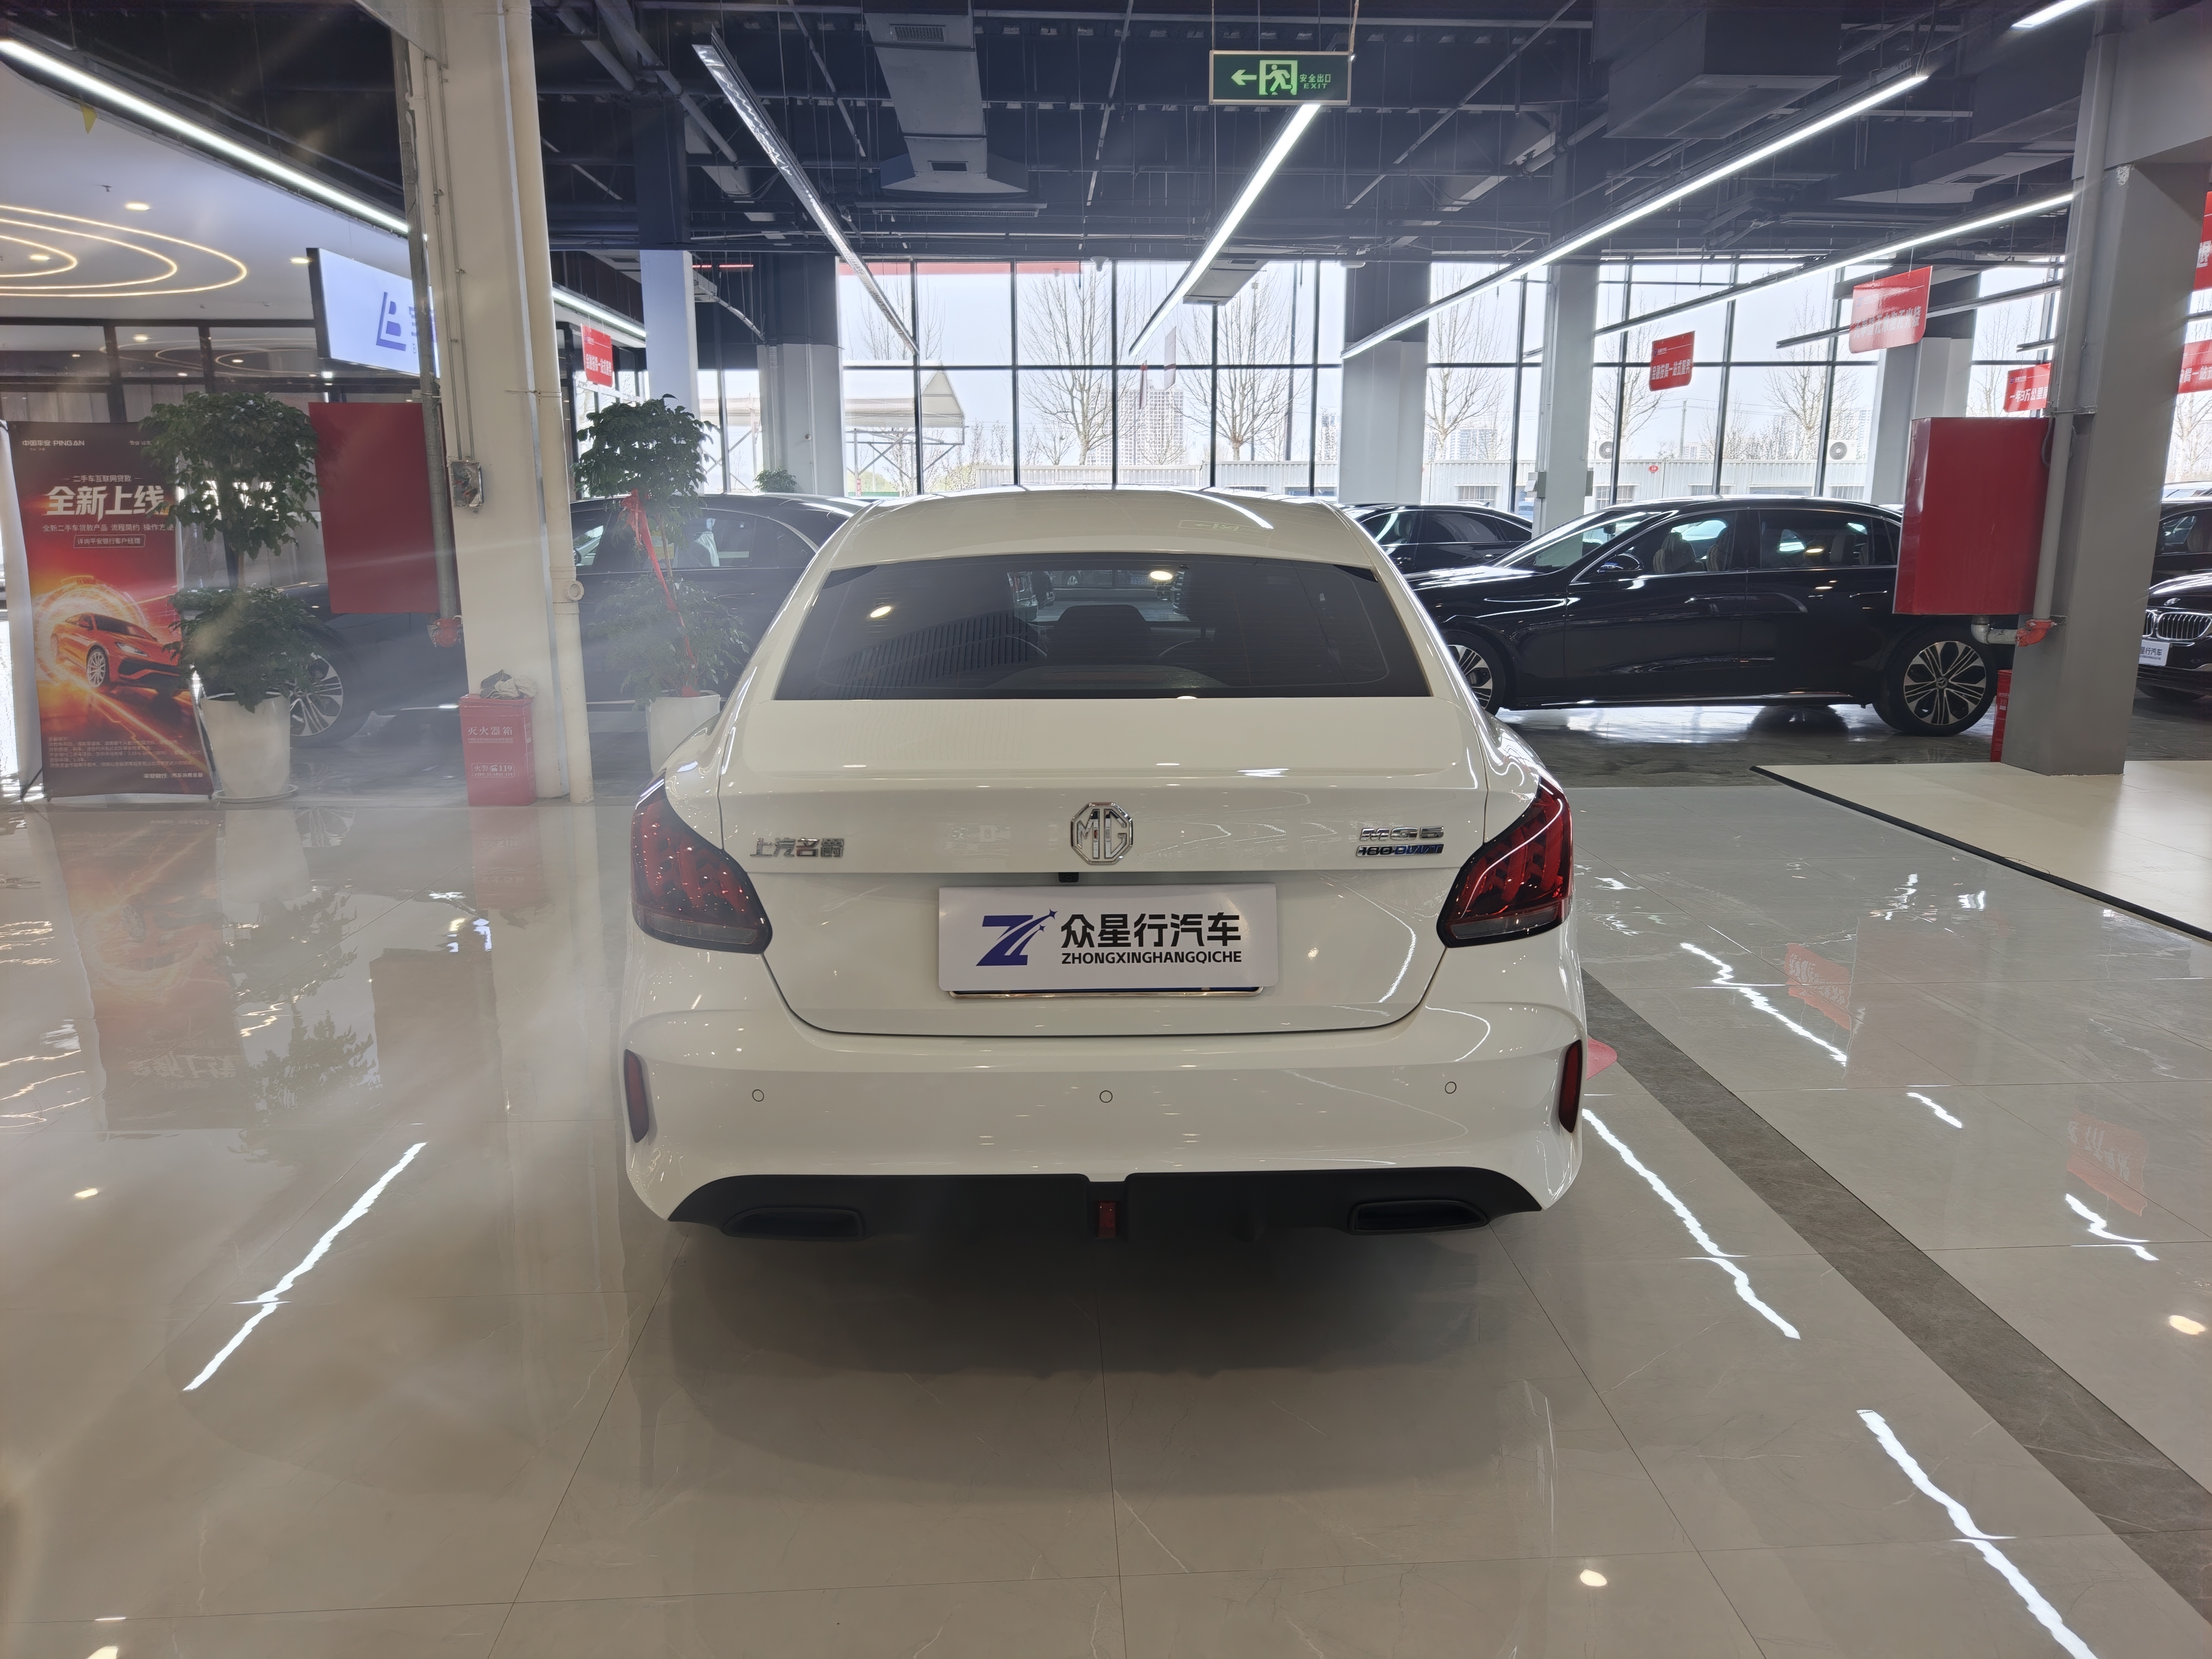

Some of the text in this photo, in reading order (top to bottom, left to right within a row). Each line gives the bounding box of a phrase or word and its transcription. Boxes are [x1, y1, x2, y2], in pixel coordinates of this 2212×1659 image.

[1299, 73, 1331, 83] 安全出口
[73, 474, 132, 482] 二手车互联网贷款
[43, 485, 166, 522] 全新上线
[468, 726, 512, 736] 灭火器箱
[1077, 808, 1128, 859] MG
[1360, 826, 1445, 841] MG5
[750, 837, 845, 858] 上汽名爵
[1061, 912, 1241, 948] 众星行汽车
[1062, 952, 1242, 964] ZHONGXINGHANGQICHE
